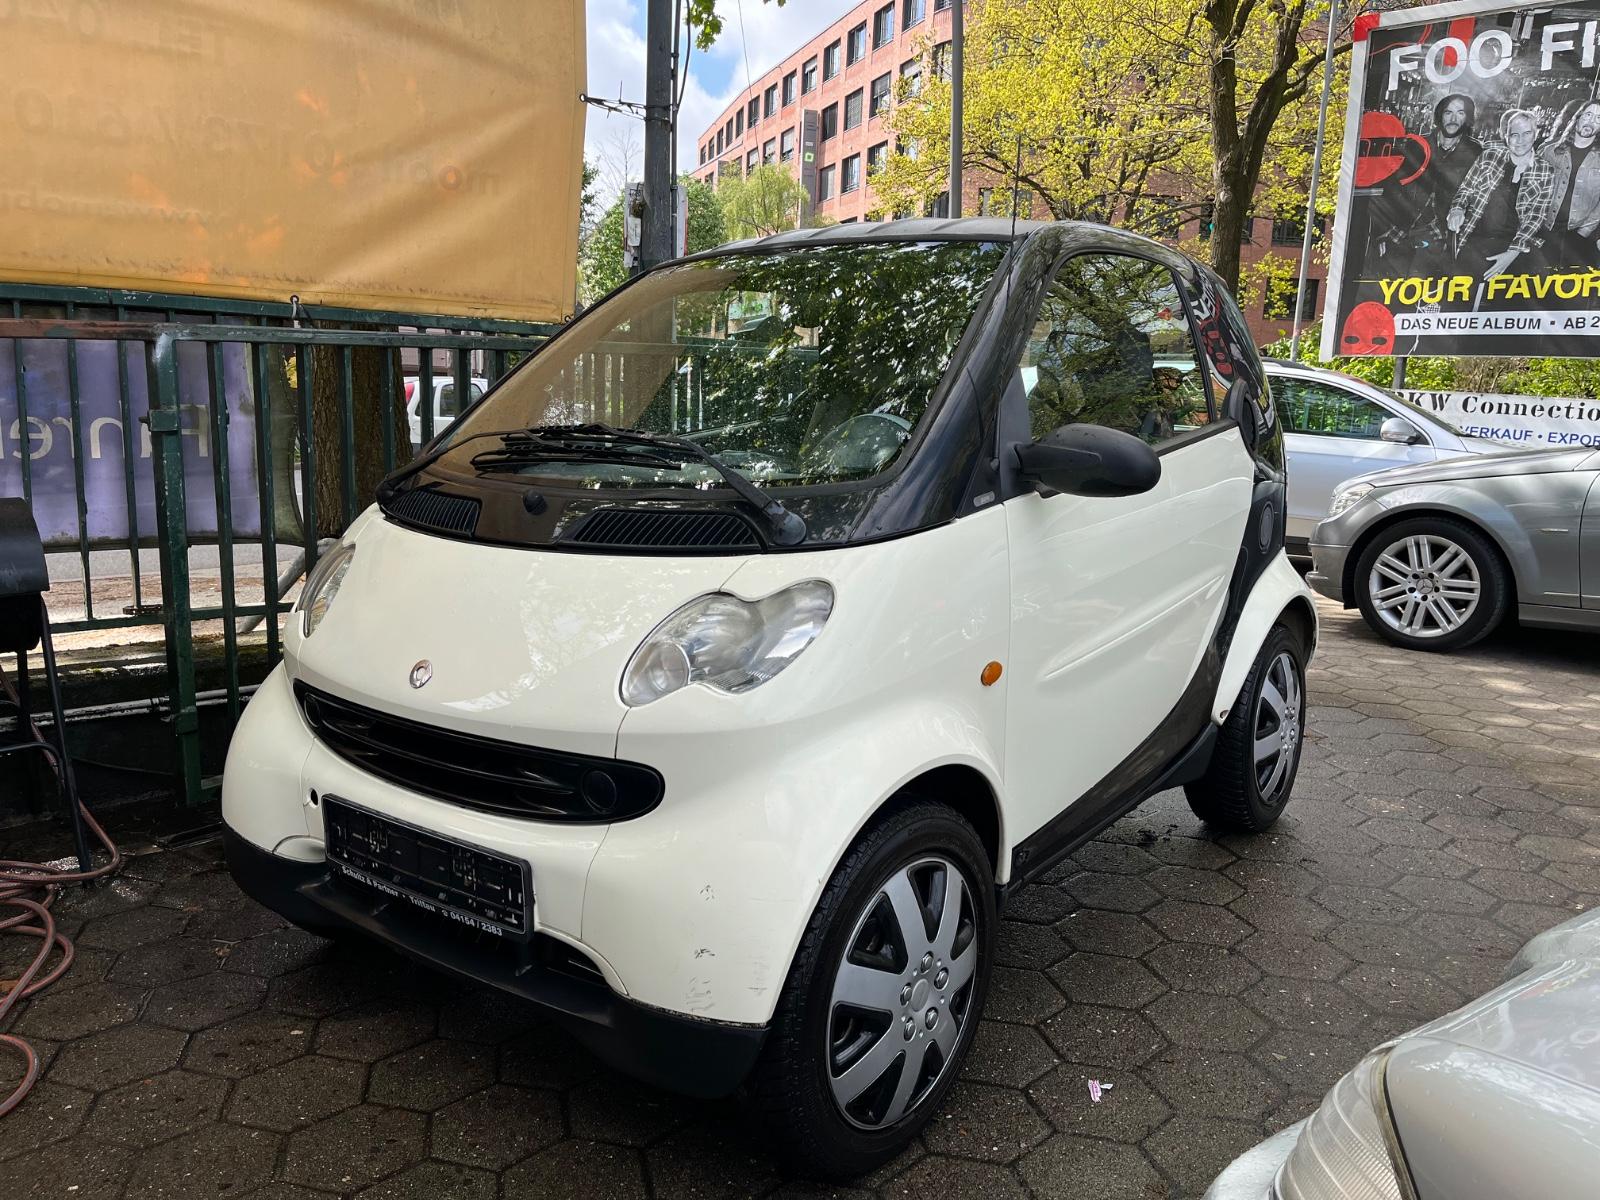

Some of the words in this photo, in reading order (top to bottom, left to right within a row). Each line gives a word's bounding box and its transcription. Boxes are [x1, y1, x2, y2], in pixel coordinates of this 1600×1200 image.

[1387, 29, 1513, 92] FOO
[1540, 20, 1600, 71] FI
[1379, 275, 1473, 305] YOUR
[1486, 272, 1600, 300] FAVOR
[1401, 318, 1431, 331] DAS
[1436, 317, 1479, 330] NEUE
[1482, 317, 1541, 330] ALBUM
[1563, 316, 1586, 330] AB
[1396, 391, 1452, 412] KW
[1462, 395, 1600, 422] Connectio
